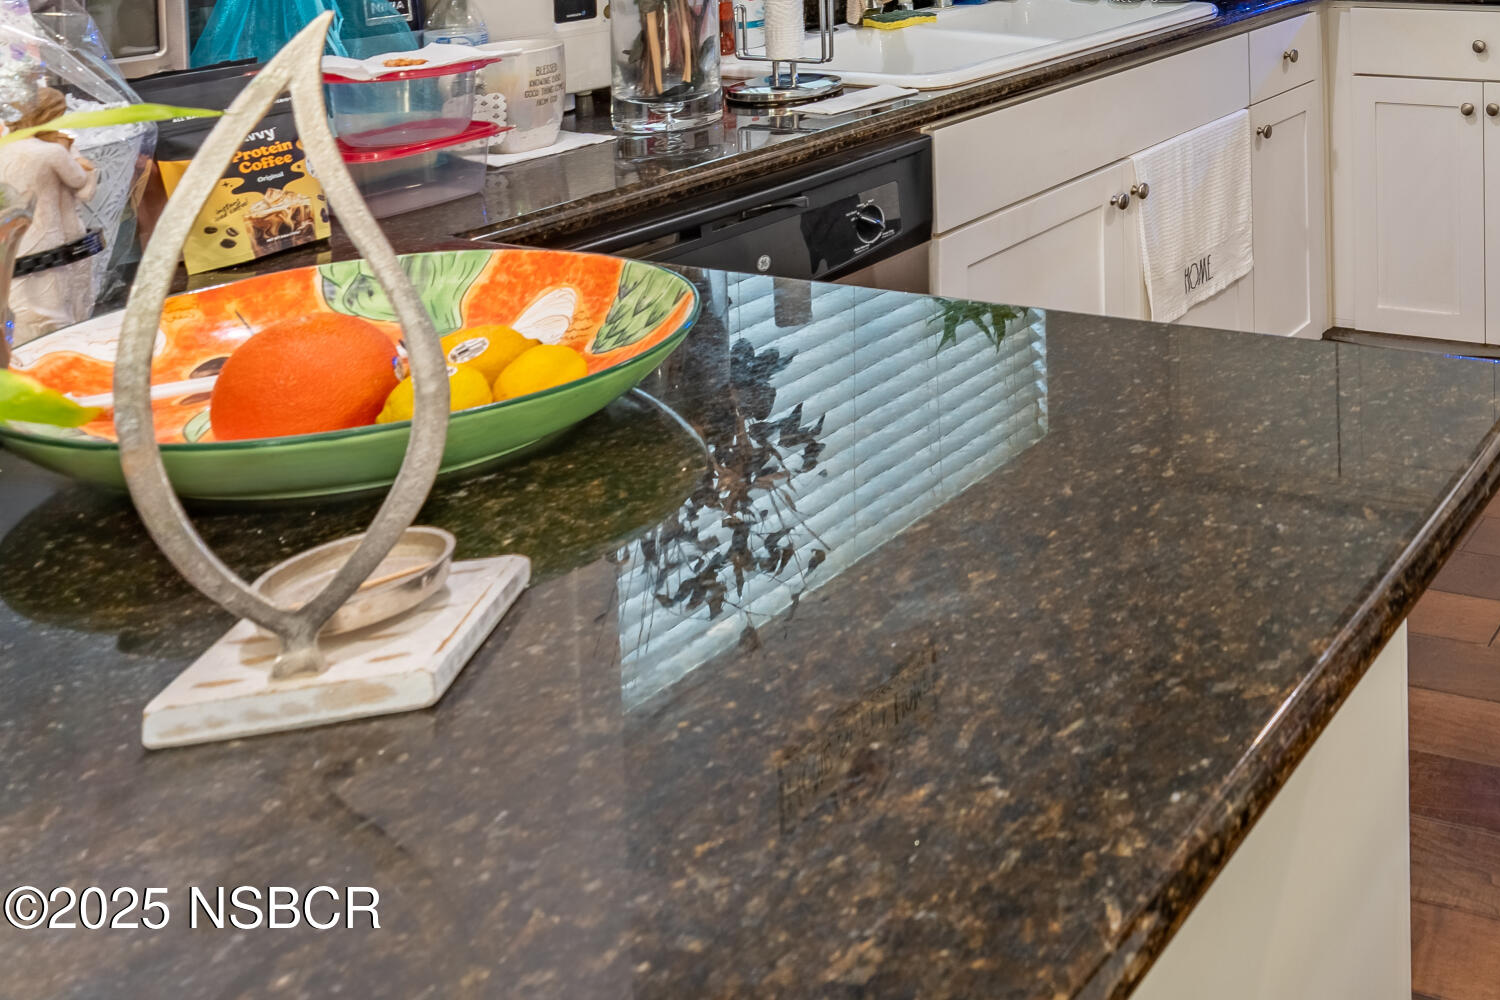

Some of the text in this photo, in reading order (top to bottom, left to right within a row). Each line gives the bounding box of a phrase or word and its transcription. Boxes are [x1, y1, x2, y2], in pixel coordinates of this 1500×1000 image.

[244, 126, 277, 142] vvy
[232, 140, 293, 164] Protein
[238, 153, 293, 174] Coffee
[256, 171, 285, 184] Original
[1184, 254, 1213, 295] HOME
